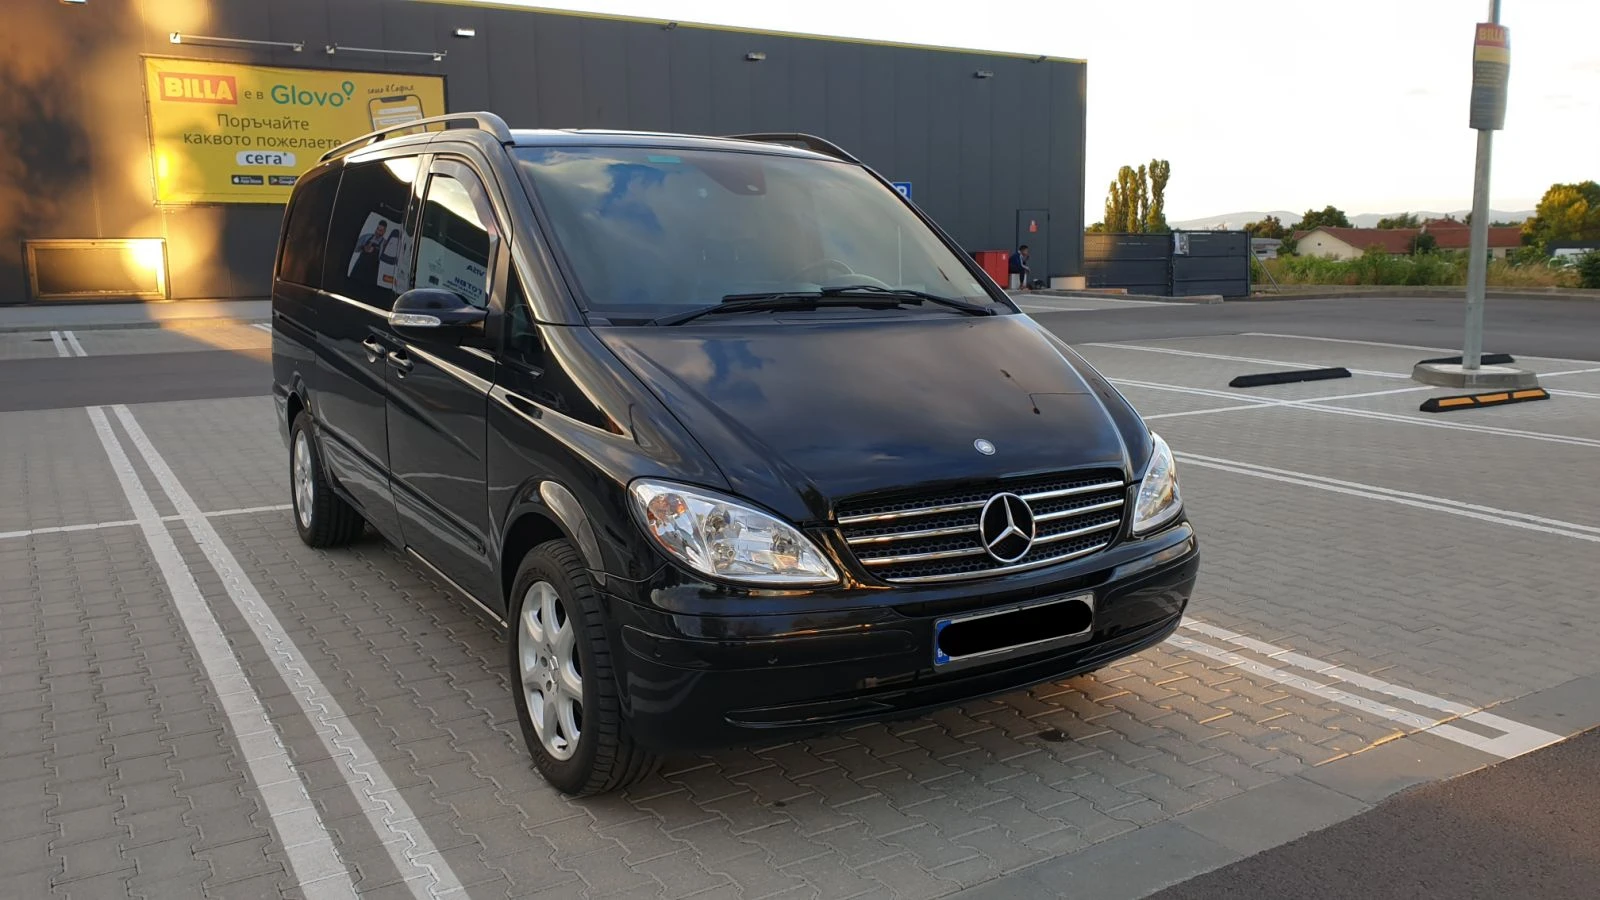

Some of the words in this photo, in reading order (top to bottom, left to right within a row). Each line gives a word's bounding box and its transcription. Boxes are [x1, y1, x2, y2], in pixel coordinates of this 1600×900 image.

[164, 77, 234, 101] BILLA
[271, 84, 344, 107] Glovo
[217, 113, 309, 131] Поръчайте
[183, 132, 251, 147] каквото
[256, 135, 342, 149] пожелаете
